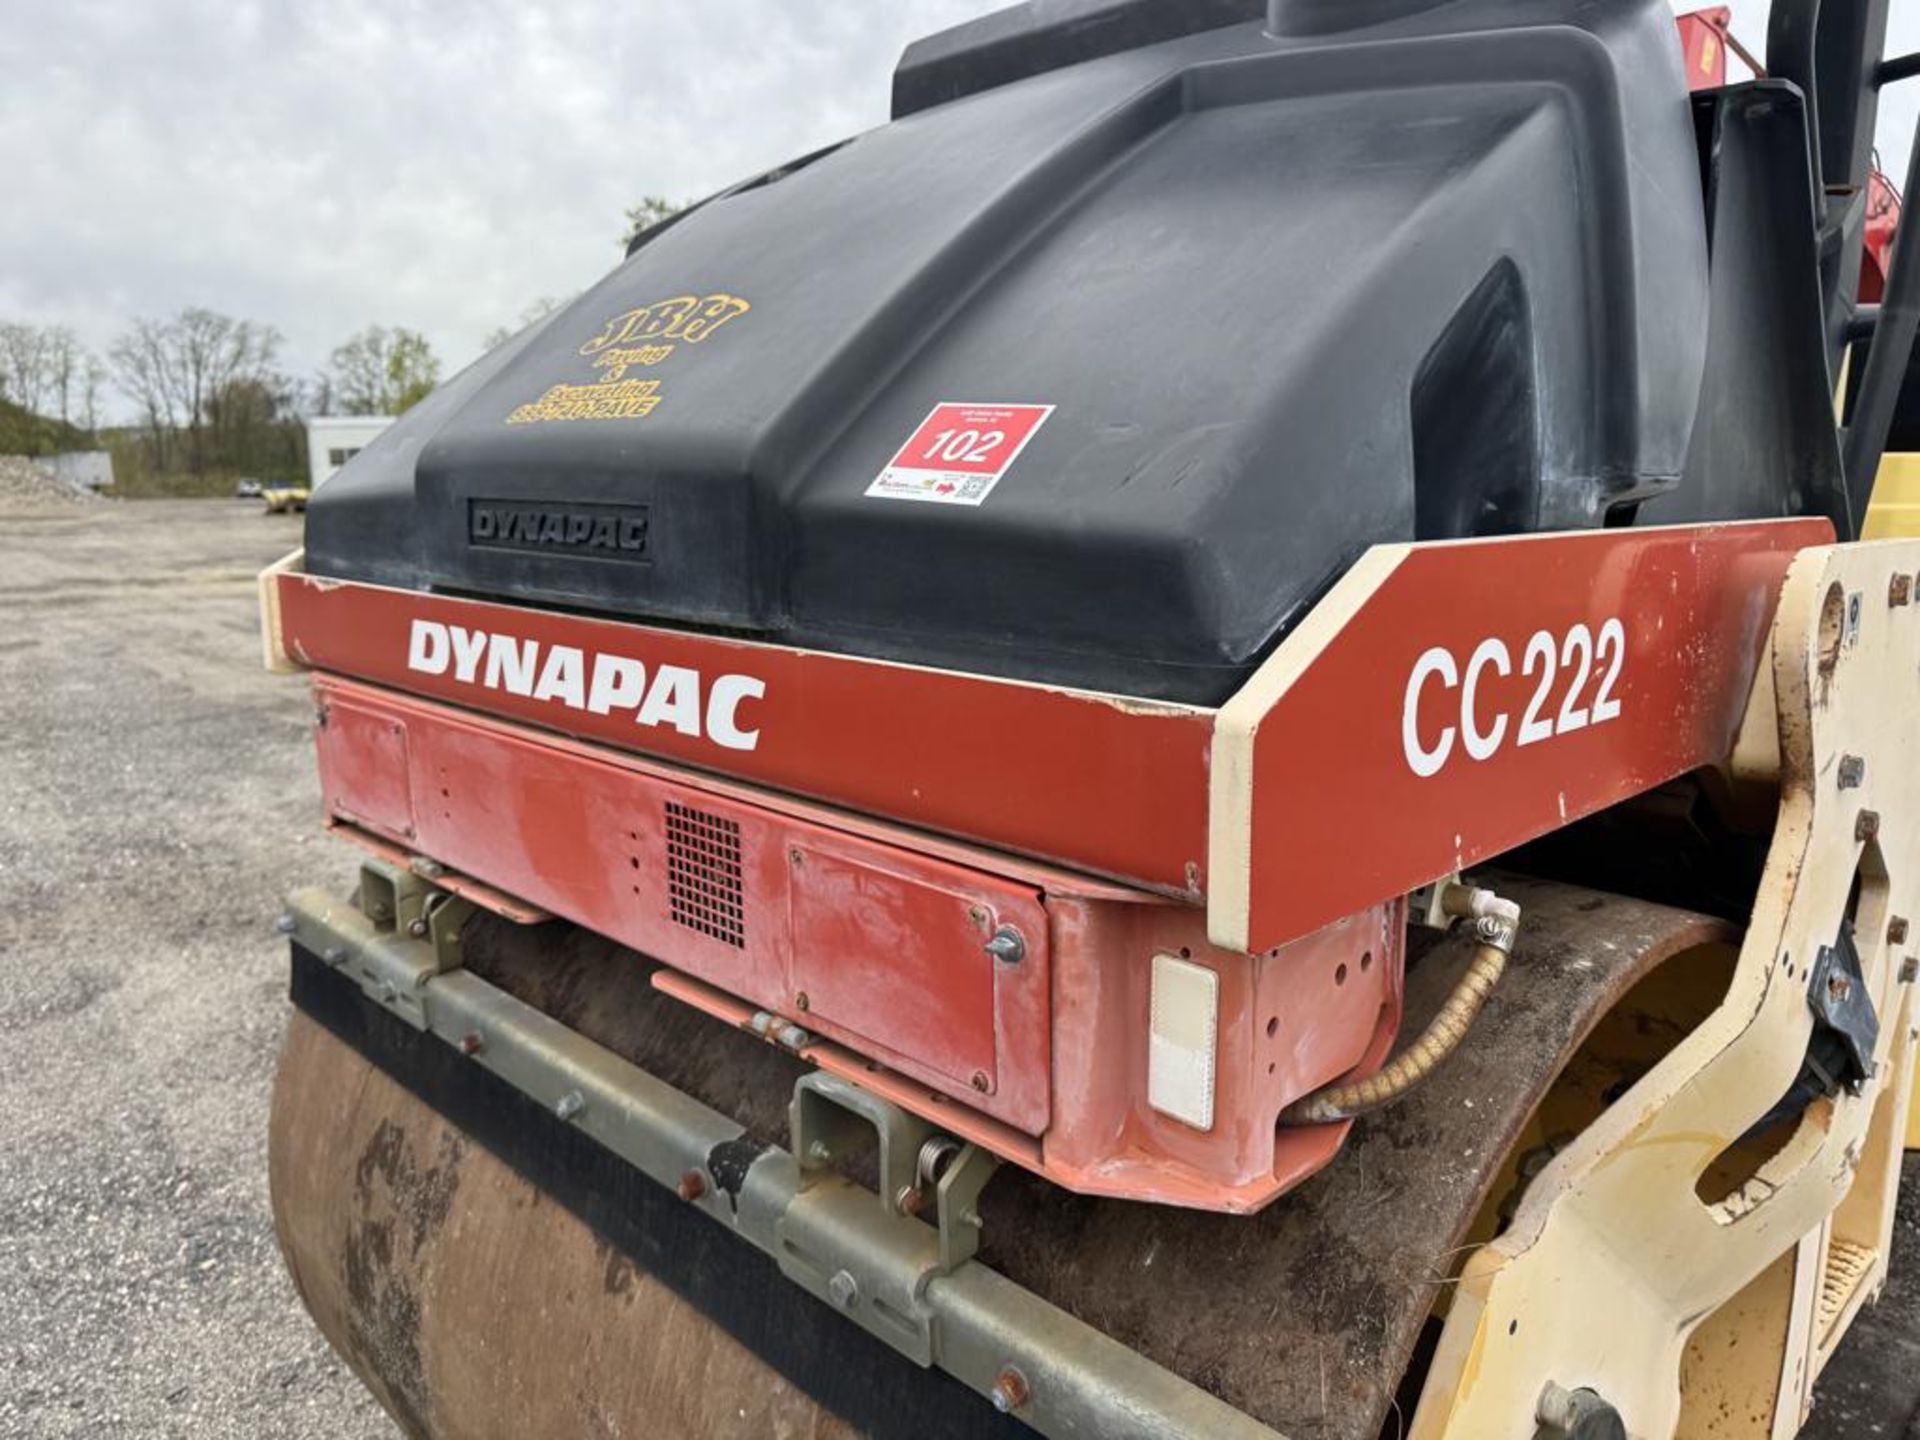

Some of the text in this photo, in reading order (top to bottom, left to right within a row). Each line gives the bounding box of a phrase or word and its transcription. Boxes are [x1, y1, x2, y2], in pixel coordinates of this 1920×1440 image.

[922, 429, 1005, 463] 102
[472, 509, 649, 550] DYNAPAC
[407, 618, 766, 751] DYNAPAC
